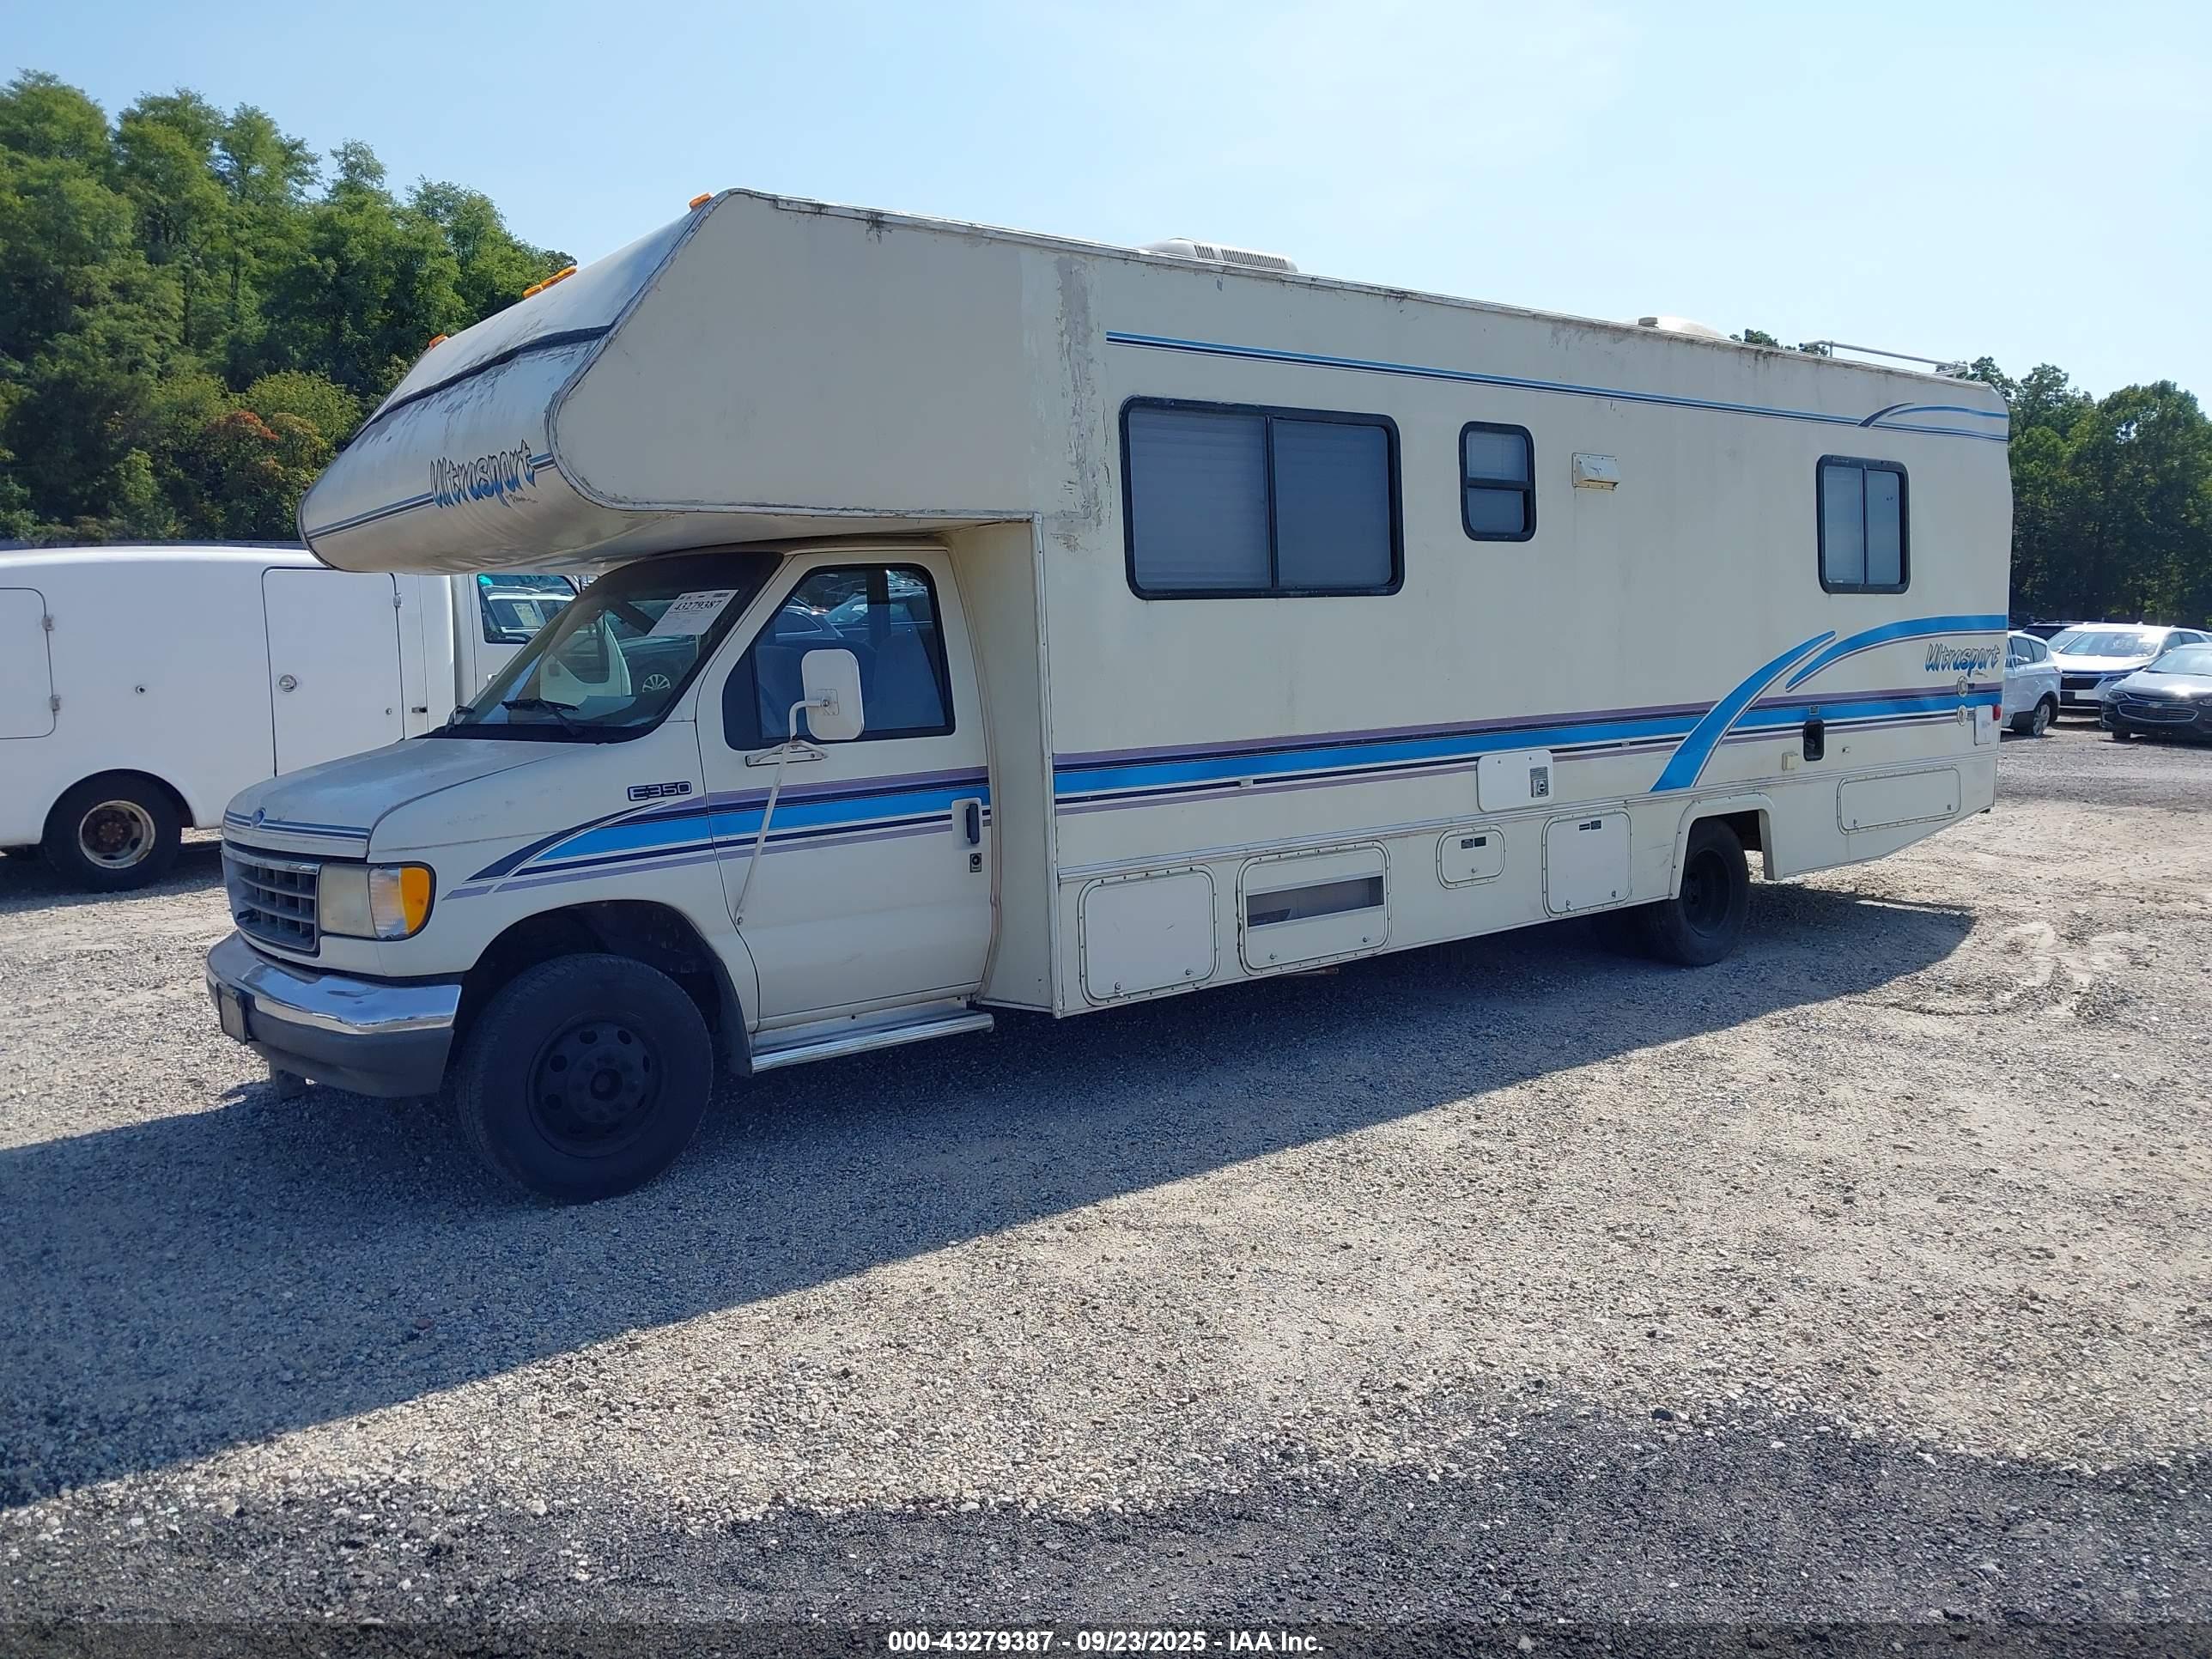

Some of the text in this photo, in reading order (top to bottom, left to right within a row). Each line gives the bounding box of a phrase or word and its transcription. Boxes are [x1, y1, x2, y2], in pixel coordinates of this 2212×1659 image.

[429, 438, 537, 508] Ultrasport
[674, 599, 723, 611] 43279387
[1924, 642, 2001, 678] Ultrasport
